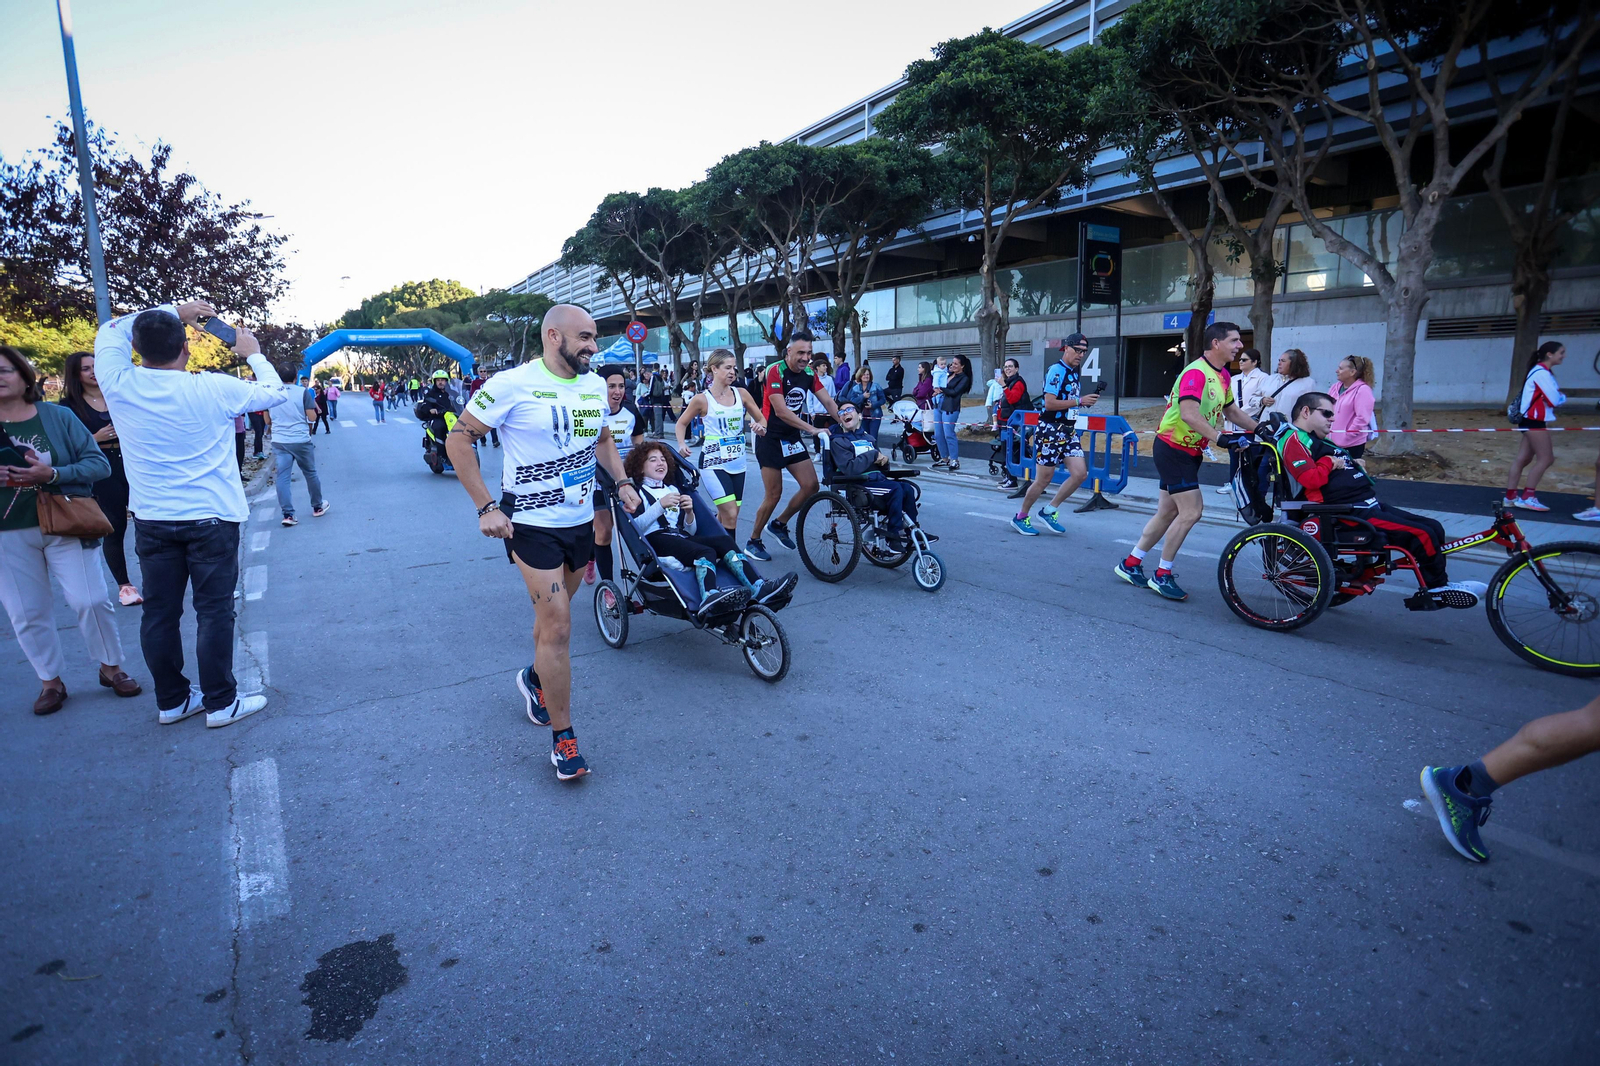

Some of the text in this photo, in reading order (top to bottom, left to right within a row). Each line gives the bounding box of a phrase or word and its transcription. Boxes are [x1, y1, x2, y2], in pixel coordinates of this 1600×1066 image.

[1170, 315, 1178, 328] 4
[1081, 347, 1101, 382] 4
[572, 409, 601, 418] CARROS
[573, 419, 584, 428] DE
[573, 428, 598, 437] FUEGO
[726, 445, 741, 454] 926
[1440, 534, 1484, 551] LUSION
